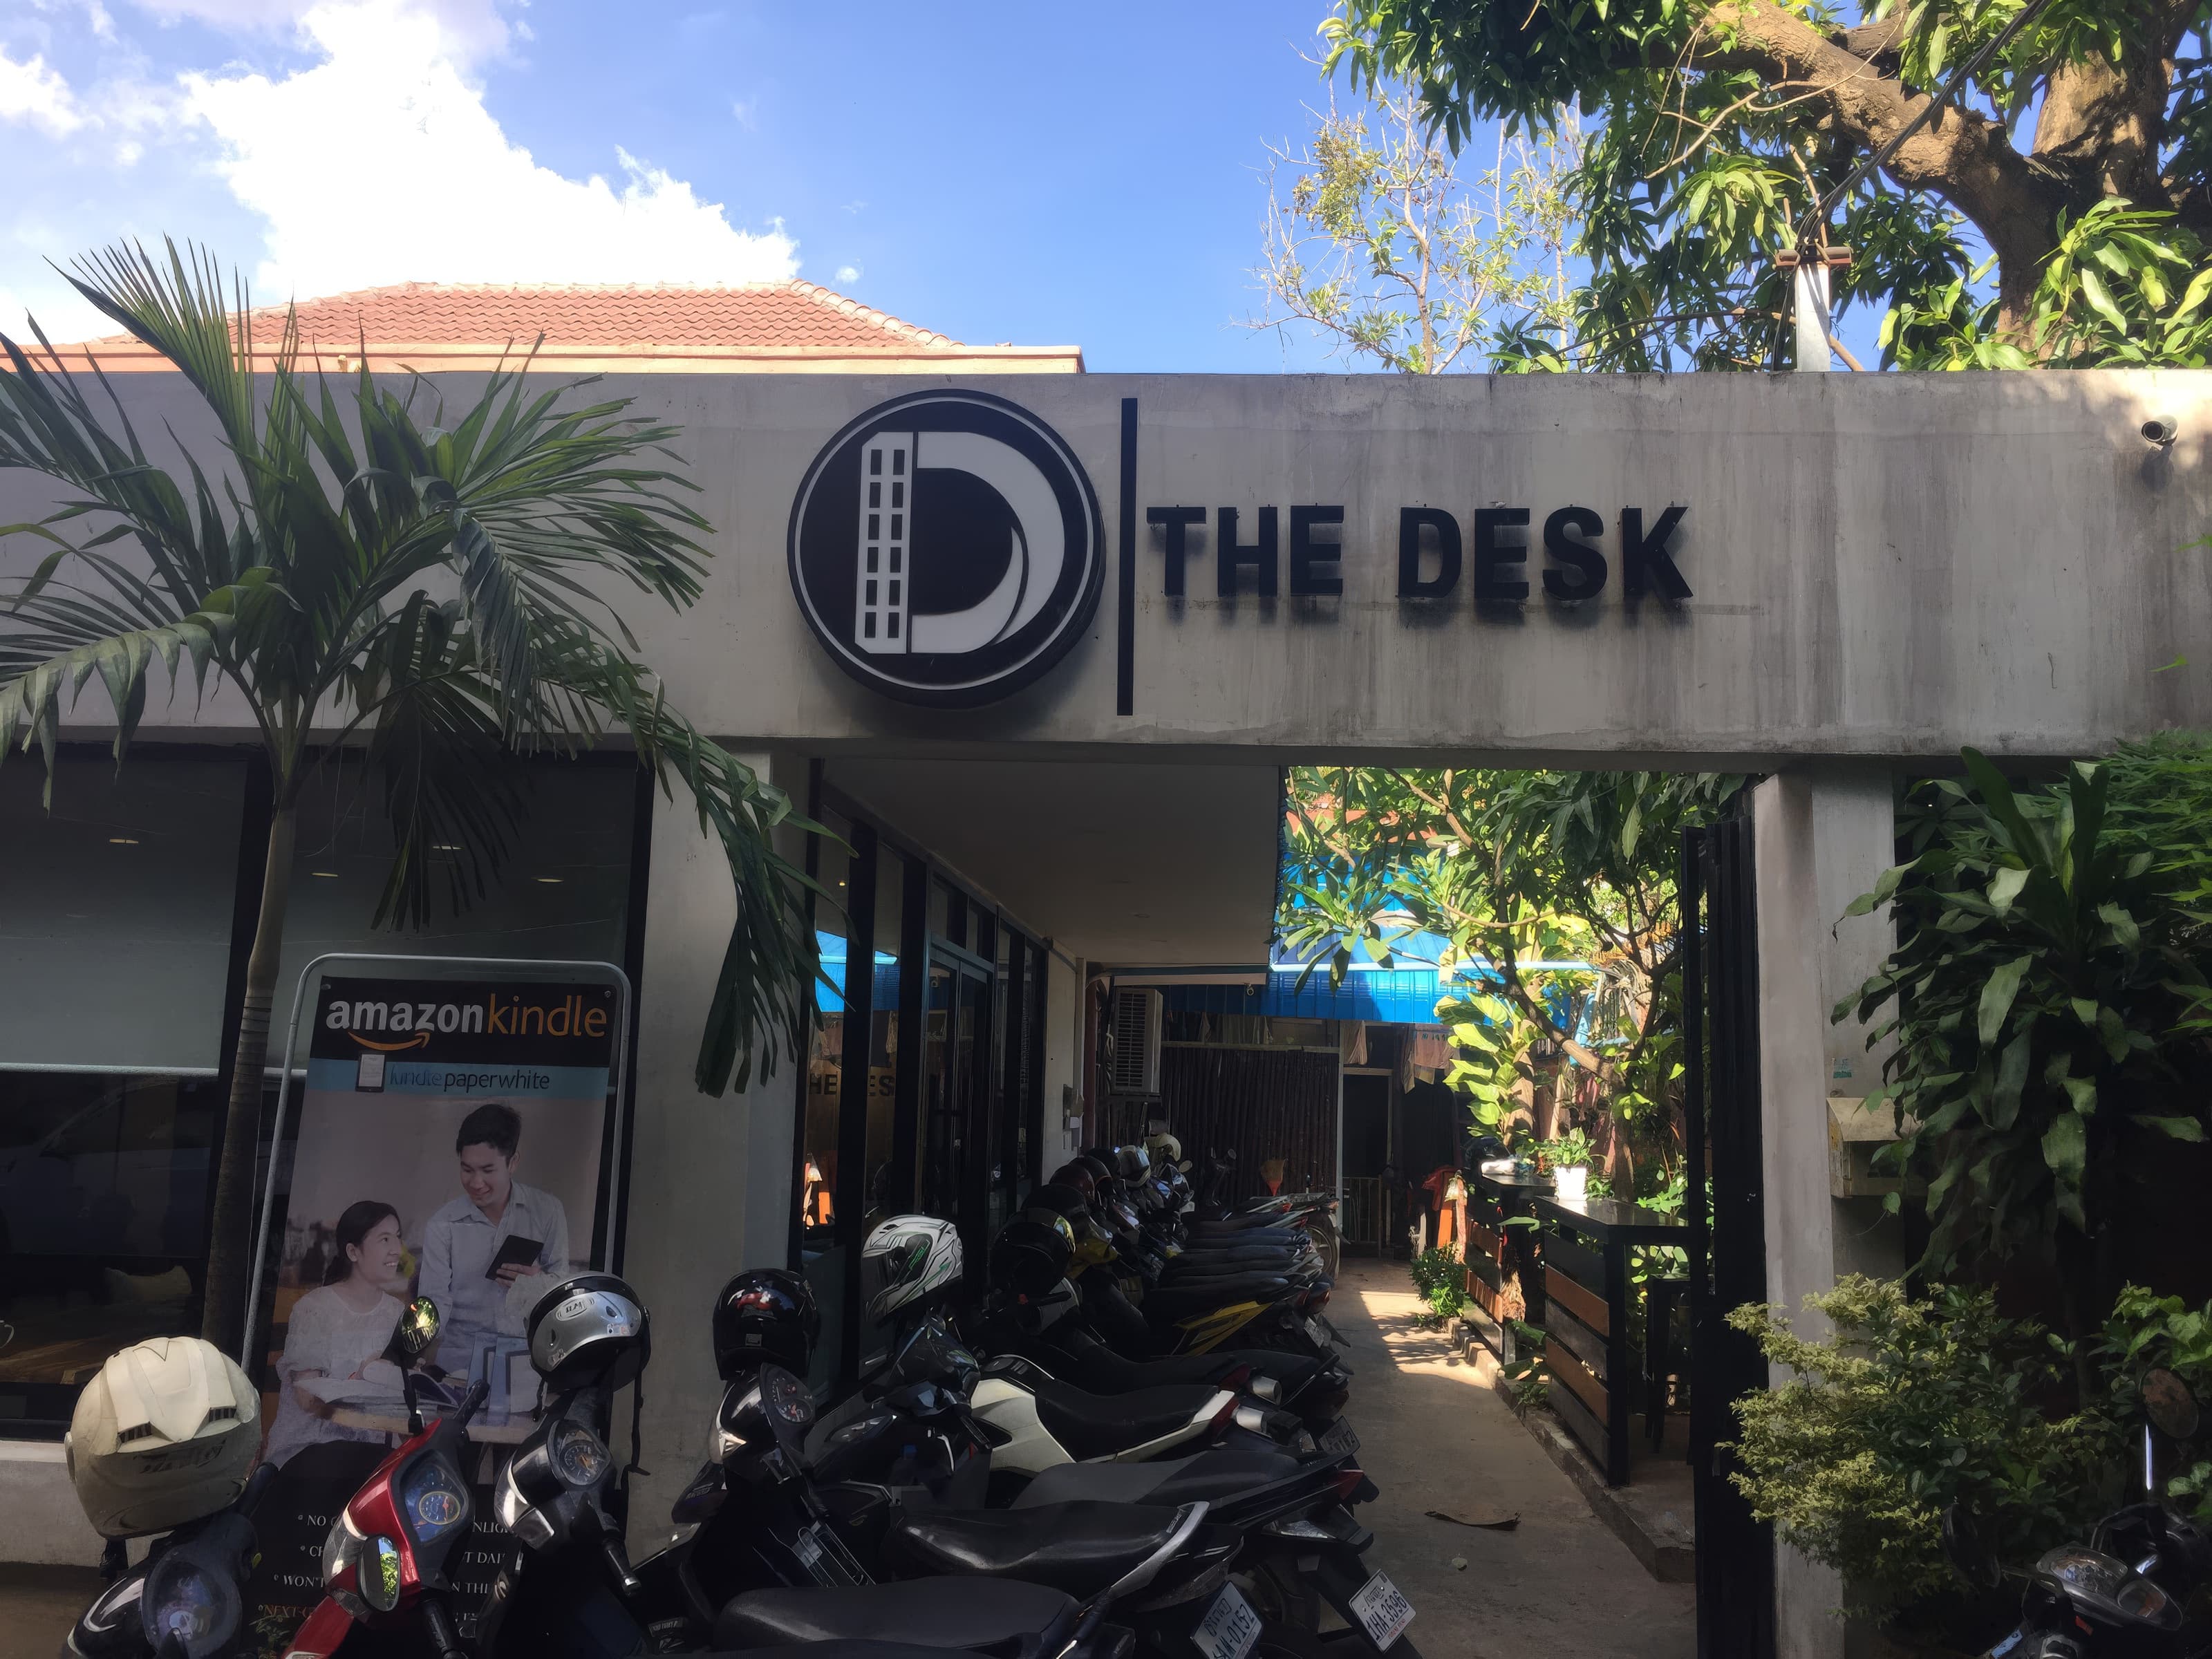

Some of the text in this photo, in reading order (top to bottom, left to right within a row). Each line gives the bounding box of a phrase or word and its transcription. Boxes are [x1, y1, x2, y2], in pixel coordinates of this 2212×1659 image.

[1147, 505, 1695, 601] THE DESK
[809, 1073, 838, 1095] HE
[307, 1515, 326, 1526] NO
[472, 1521, 507, 1533] NLIG
